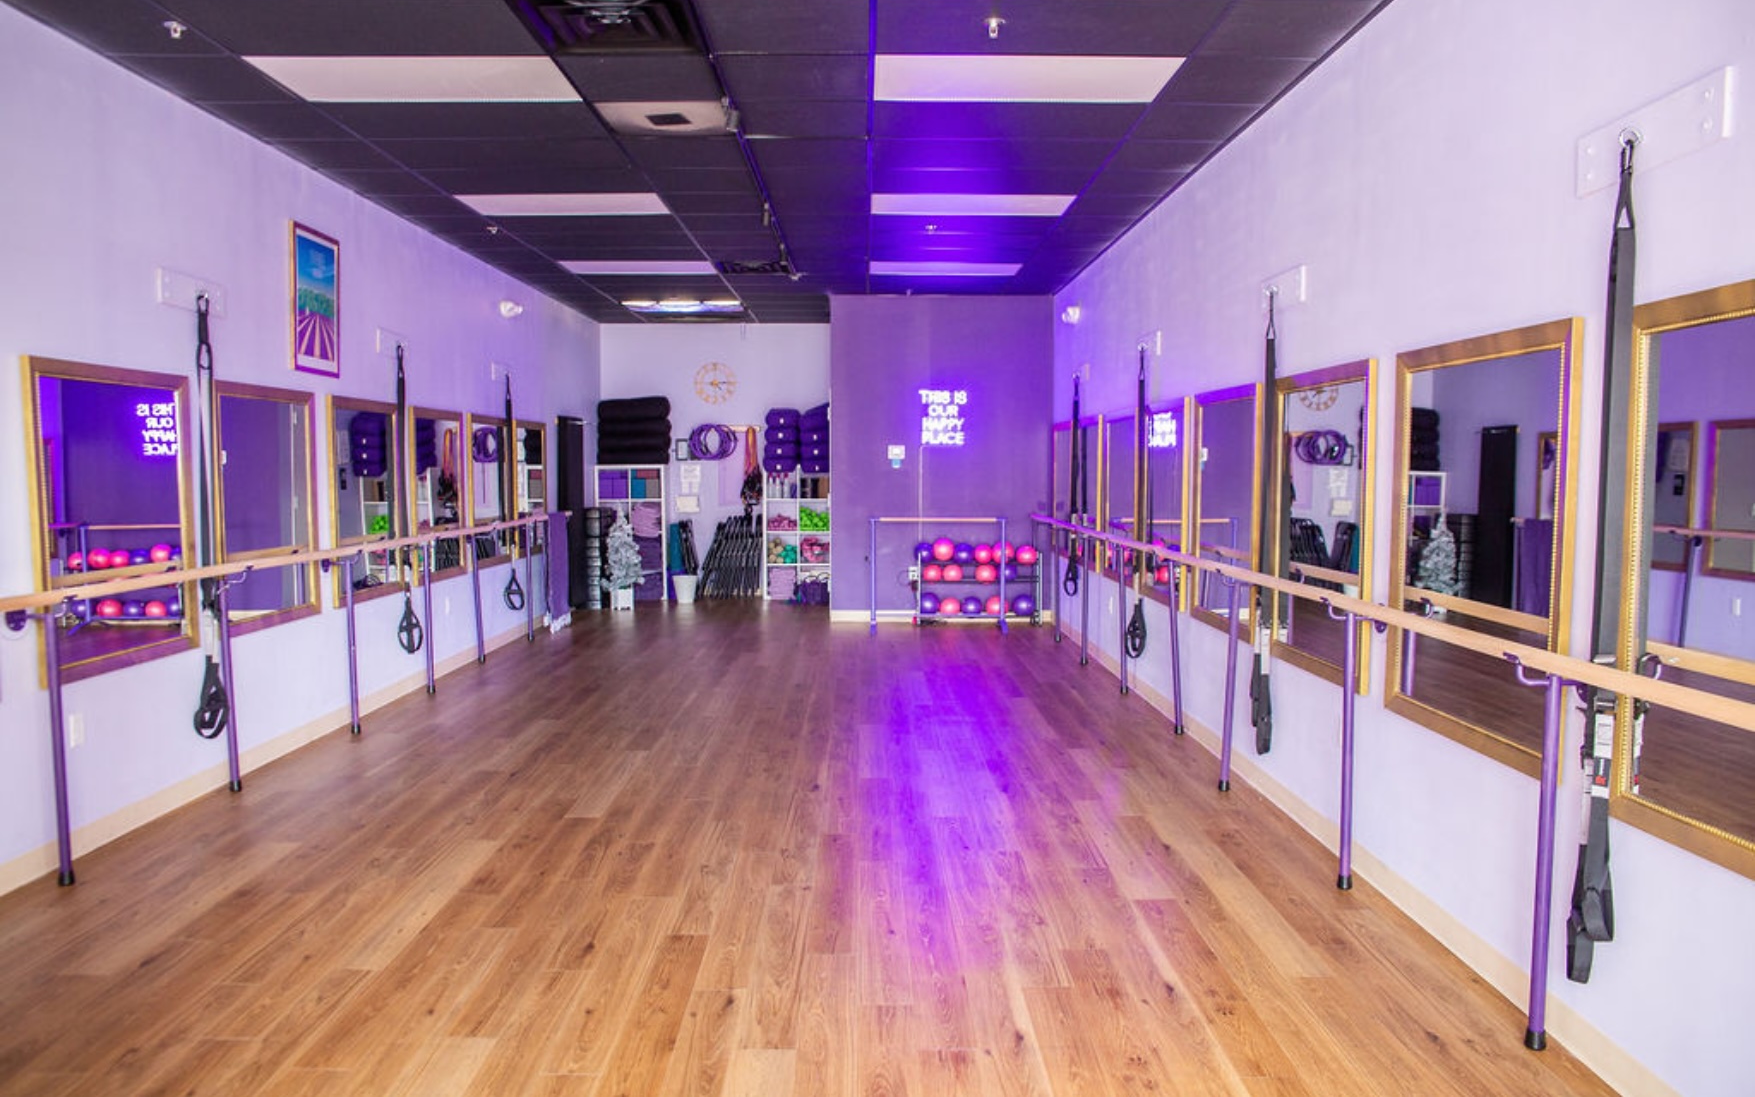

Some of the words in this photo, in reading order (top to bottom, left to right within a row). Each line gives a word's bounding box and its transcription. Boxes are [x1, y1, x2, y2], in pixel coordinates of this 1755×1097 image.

[918, 390, 951, 404] THIS
[954, 390, 968, 404] IS
[928, 405, 959, 417] OUR
[922, 417, 965, 432] HAPPY
[922, 432, 965, 445] PLACE
